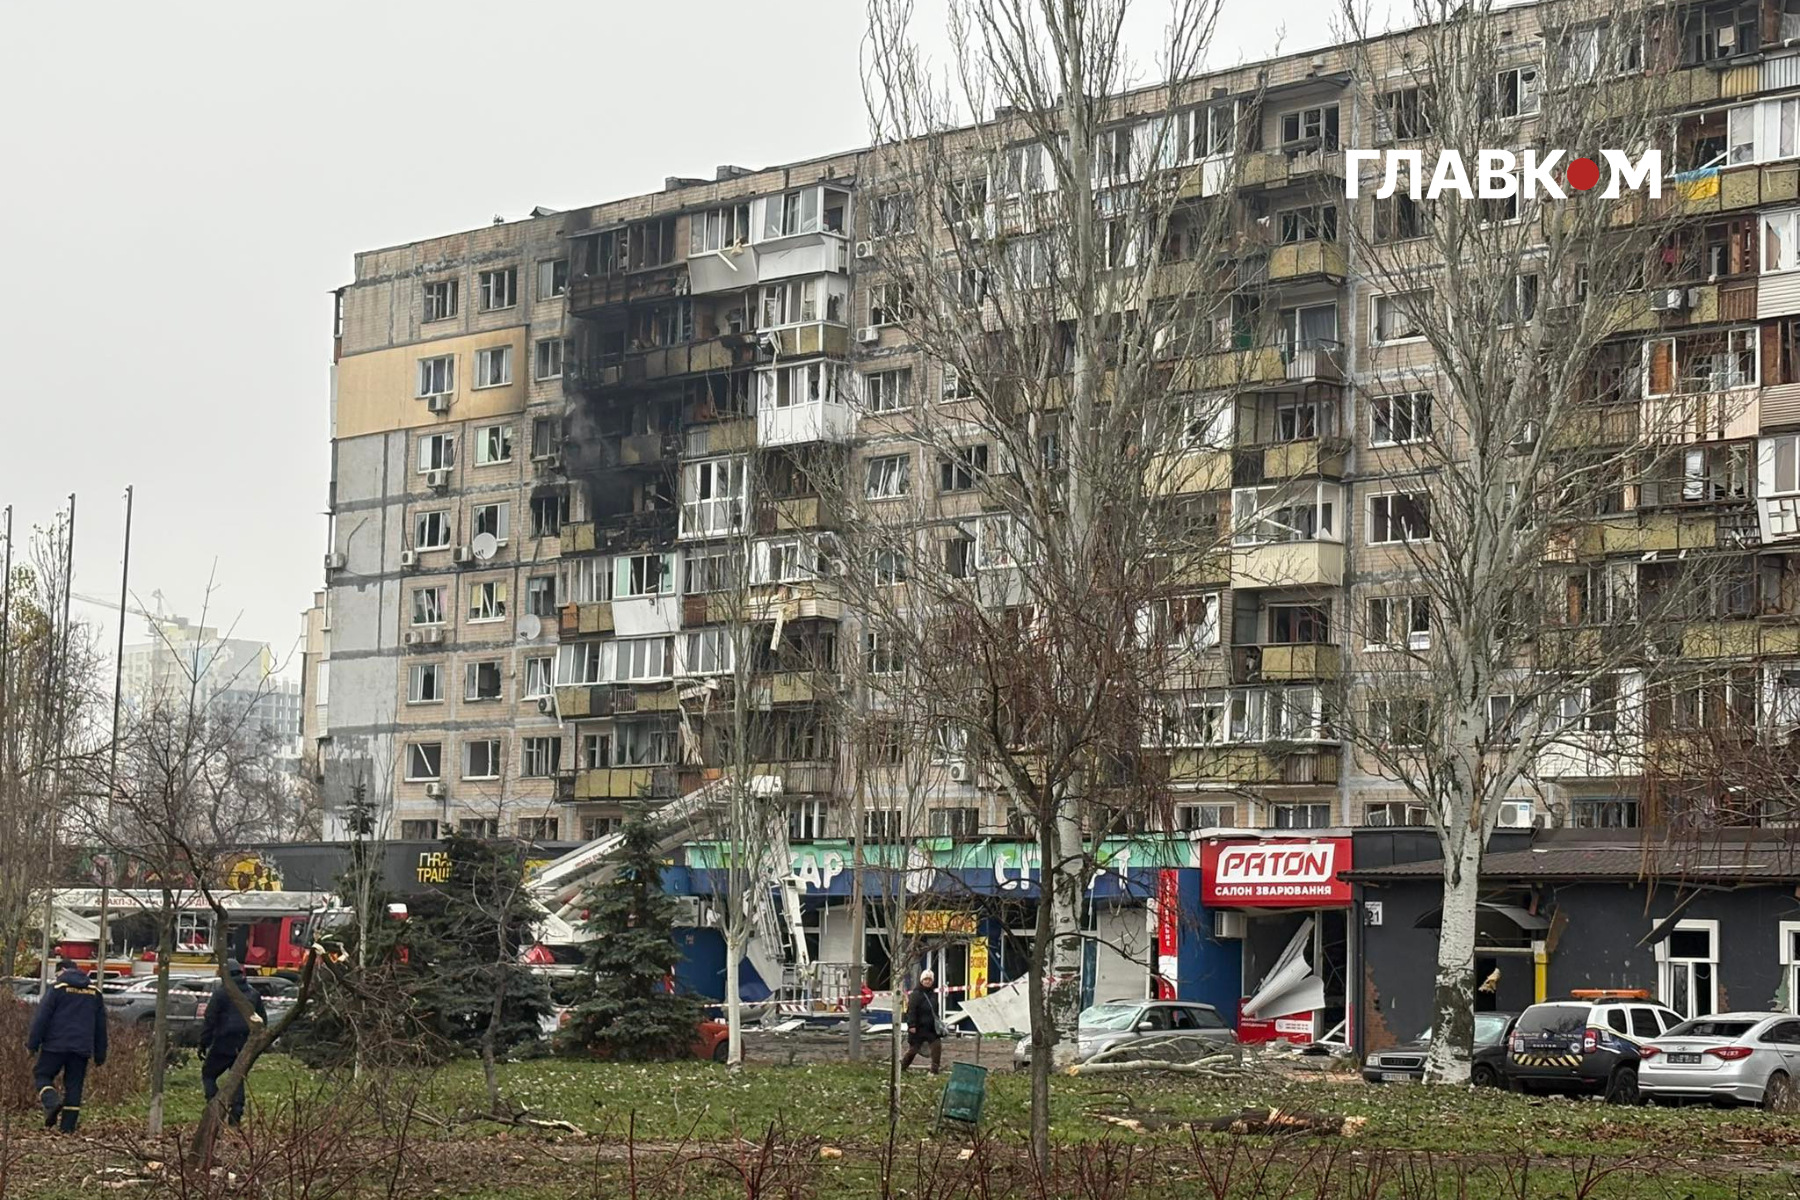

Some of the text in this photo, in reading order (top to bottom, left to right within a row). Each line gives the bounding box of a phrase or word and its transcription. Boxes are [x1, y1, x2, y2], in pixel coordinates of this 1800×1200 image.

[1223, 851, 1328, 877] PATON
[1215, 886, 1332, 896] САЛОН ЗВАРЮВАННЯ
